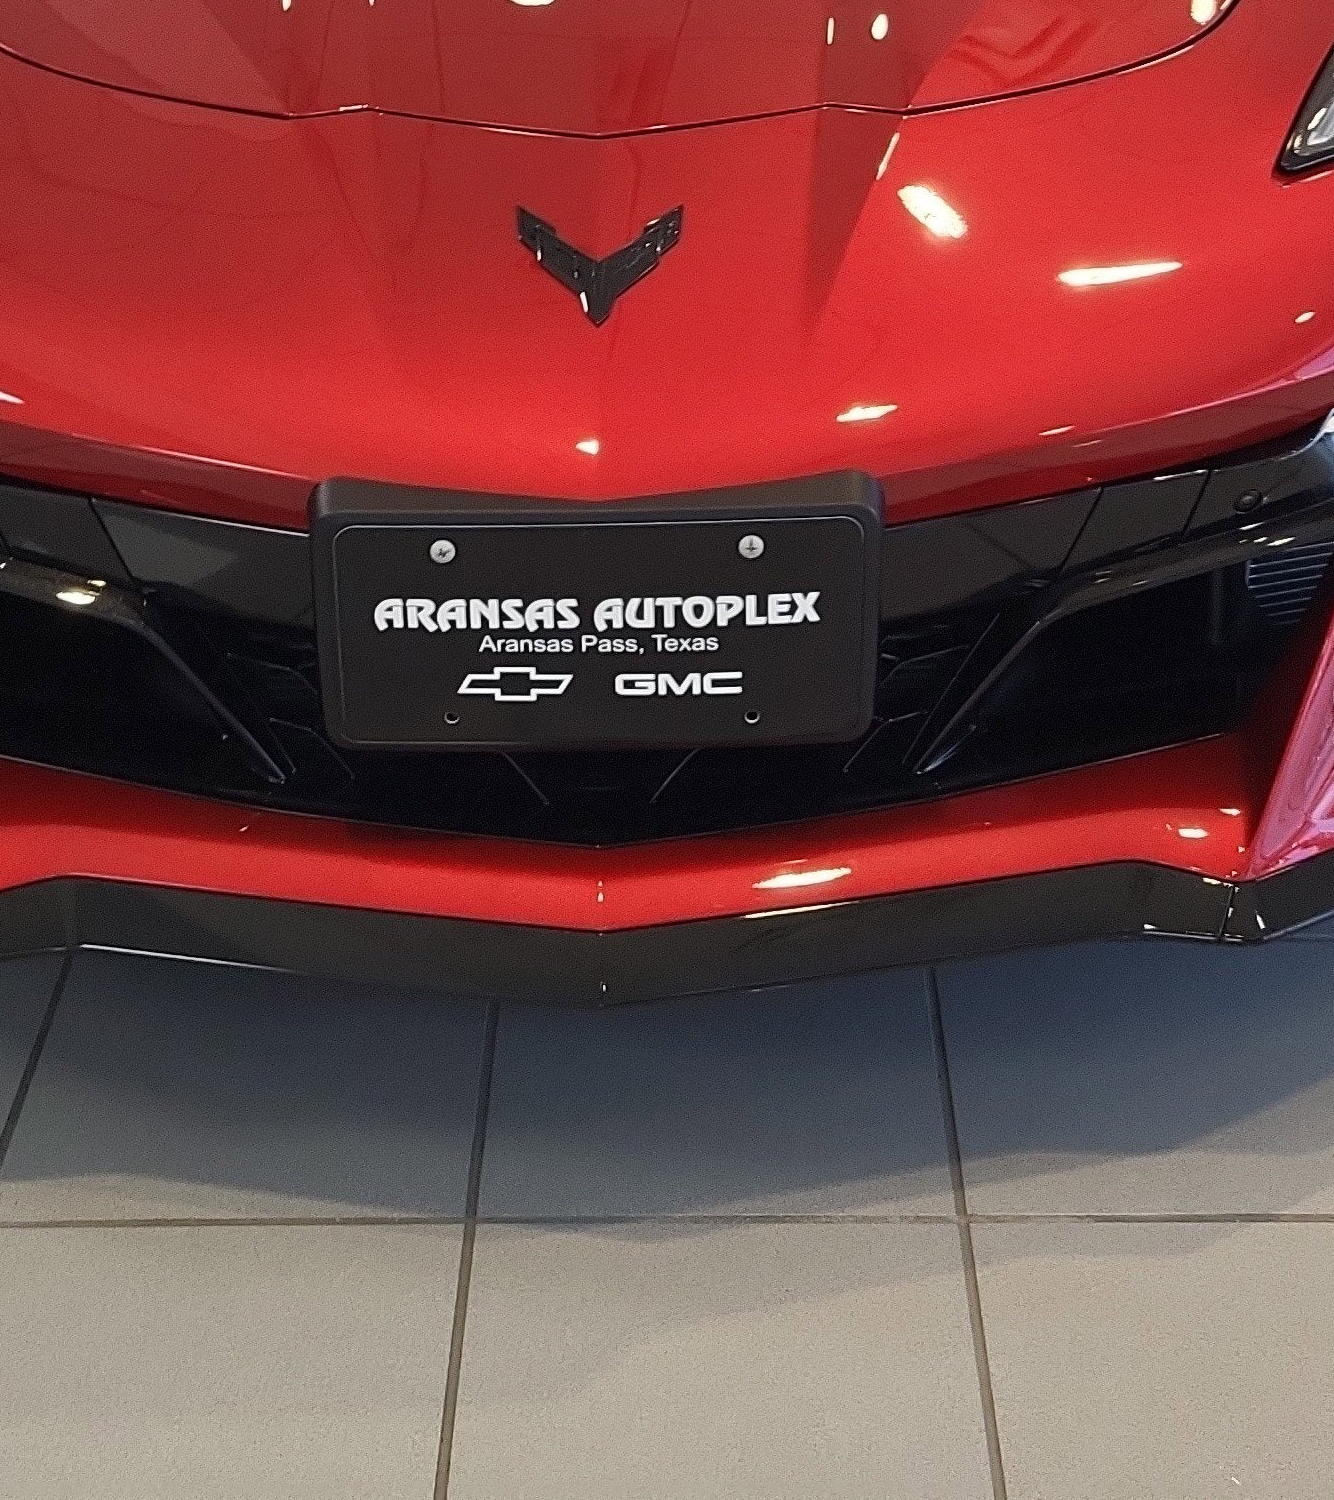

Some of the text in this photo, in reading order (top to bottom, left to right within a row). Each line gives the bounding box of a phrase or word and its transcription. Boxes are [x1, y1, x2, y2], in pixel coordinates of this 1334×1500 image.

[373, 591, 821, 633] ARANSAS AUTOPLEX
[478, 633, 719, 655] Aransas Pass, Texas
[614, 671, 743, 696] GMC
